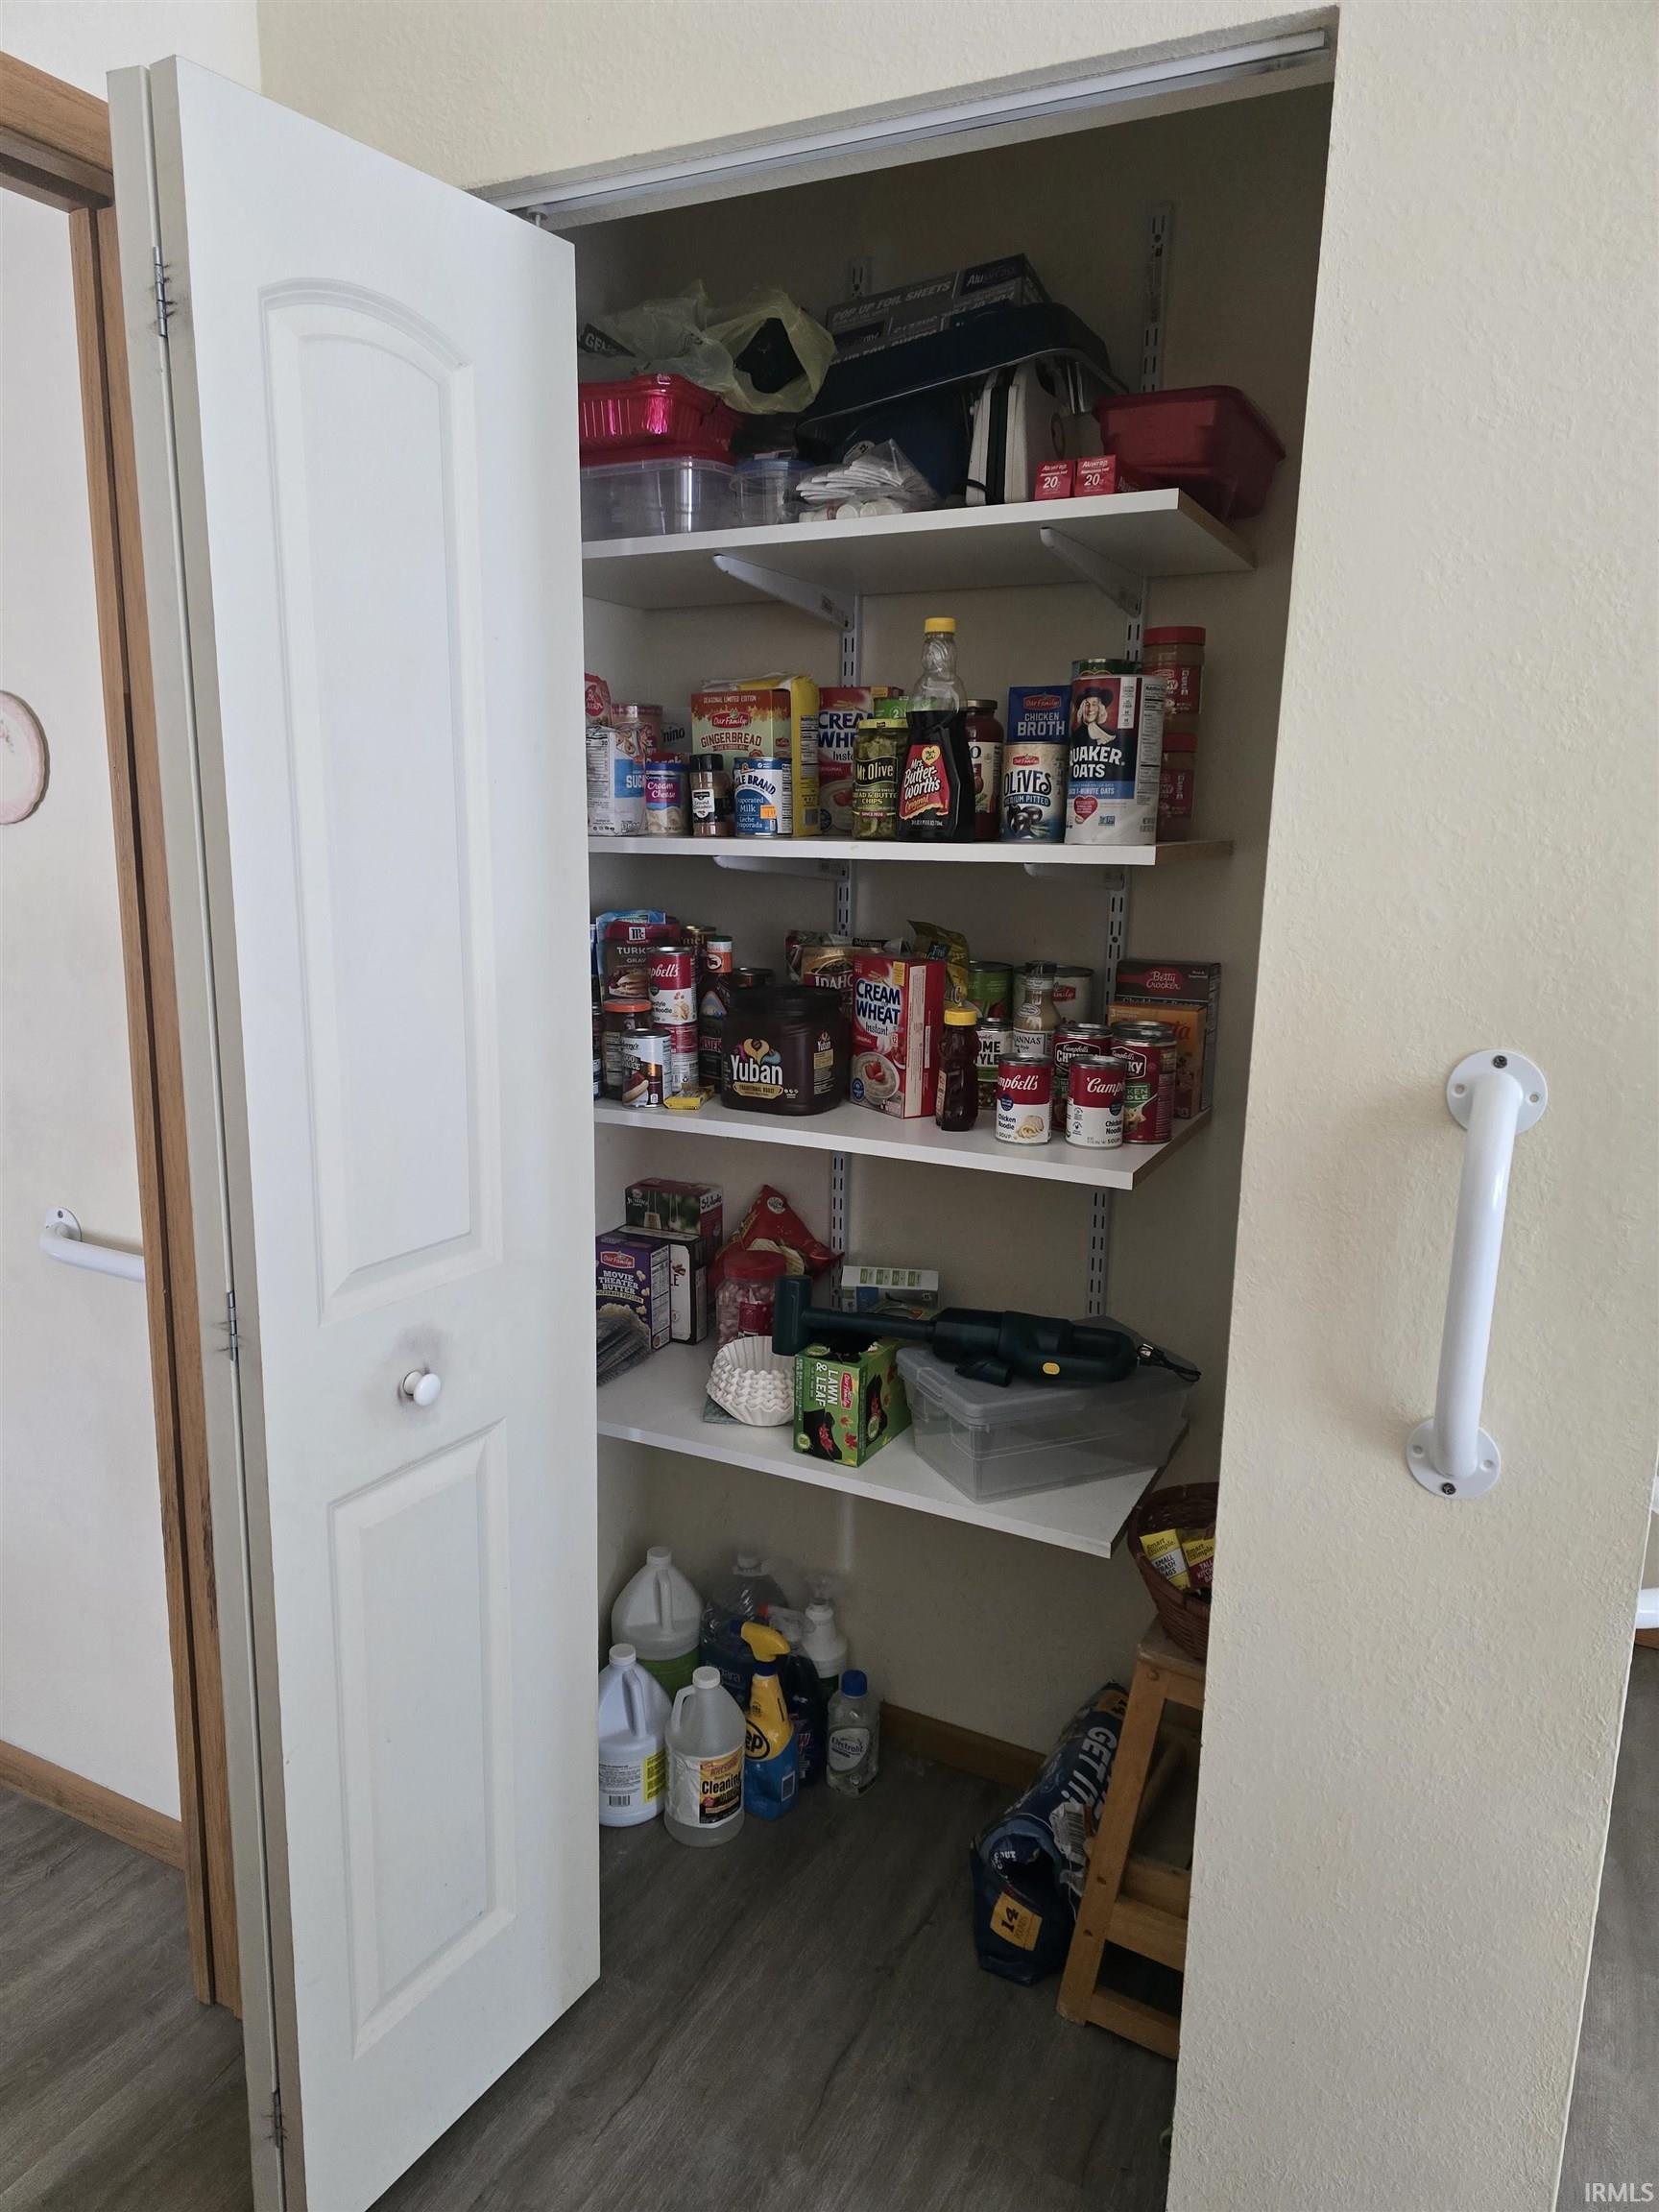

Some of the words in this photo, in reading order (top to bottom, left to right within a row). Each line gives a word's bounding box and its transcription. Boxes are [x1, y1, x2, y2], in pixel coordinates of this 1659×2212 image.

[858, 301, 875, 314] UP
[877, 295, 902, 309] FOIL
[905, 280, 951, 302] SHEETS
[1043, 475, 1059, 490] 20
[1084, 473, 1100, 486] 20
[1024, 712, 1060, 721] CHICKEN
[1017, 721, 1066, 736] BROTH
[700, 732, 762, 748] GINGERBREAD
[1070, 745, 1122, 767] QUAKER
[867, 761, 894, 781] Olive
[1072, 763, 1106, 779] OATS
[646, 781, 674, 790] Cream
[747, 775, 776, 795] BRAND
[651, 789, 676, 799] Cheese
[1024, 795, 1051, 806] PITTED
[1145, 978, 1181, 990] Crocker
[1152, 971, 1176, 983] Betty
[856, 978, 901, 1006] CREAM
[854, 999, 901, 1025] WHEAT
[865, 1021, 888, 1036] Instant
[817, 1040, 831, 1052] Yuban
[730, 1054, 783, 1085] Yuban
[598, 1276, 638, 1289] THEATER
[602, 1270, 634, 1282] MOVIE
[602, 1283, 636, 1295] BUTTER
[815, 1361, 828, 1372] &
[815, 1376, 827, 1407] LEAF
[827, 1369, 839, 1406] LAWN
[1154, 1555, 1174, 1567] SMALL
[1078, 1726, 1118, 1783] GET
[1001, 1907, 1020, 1934] 14
